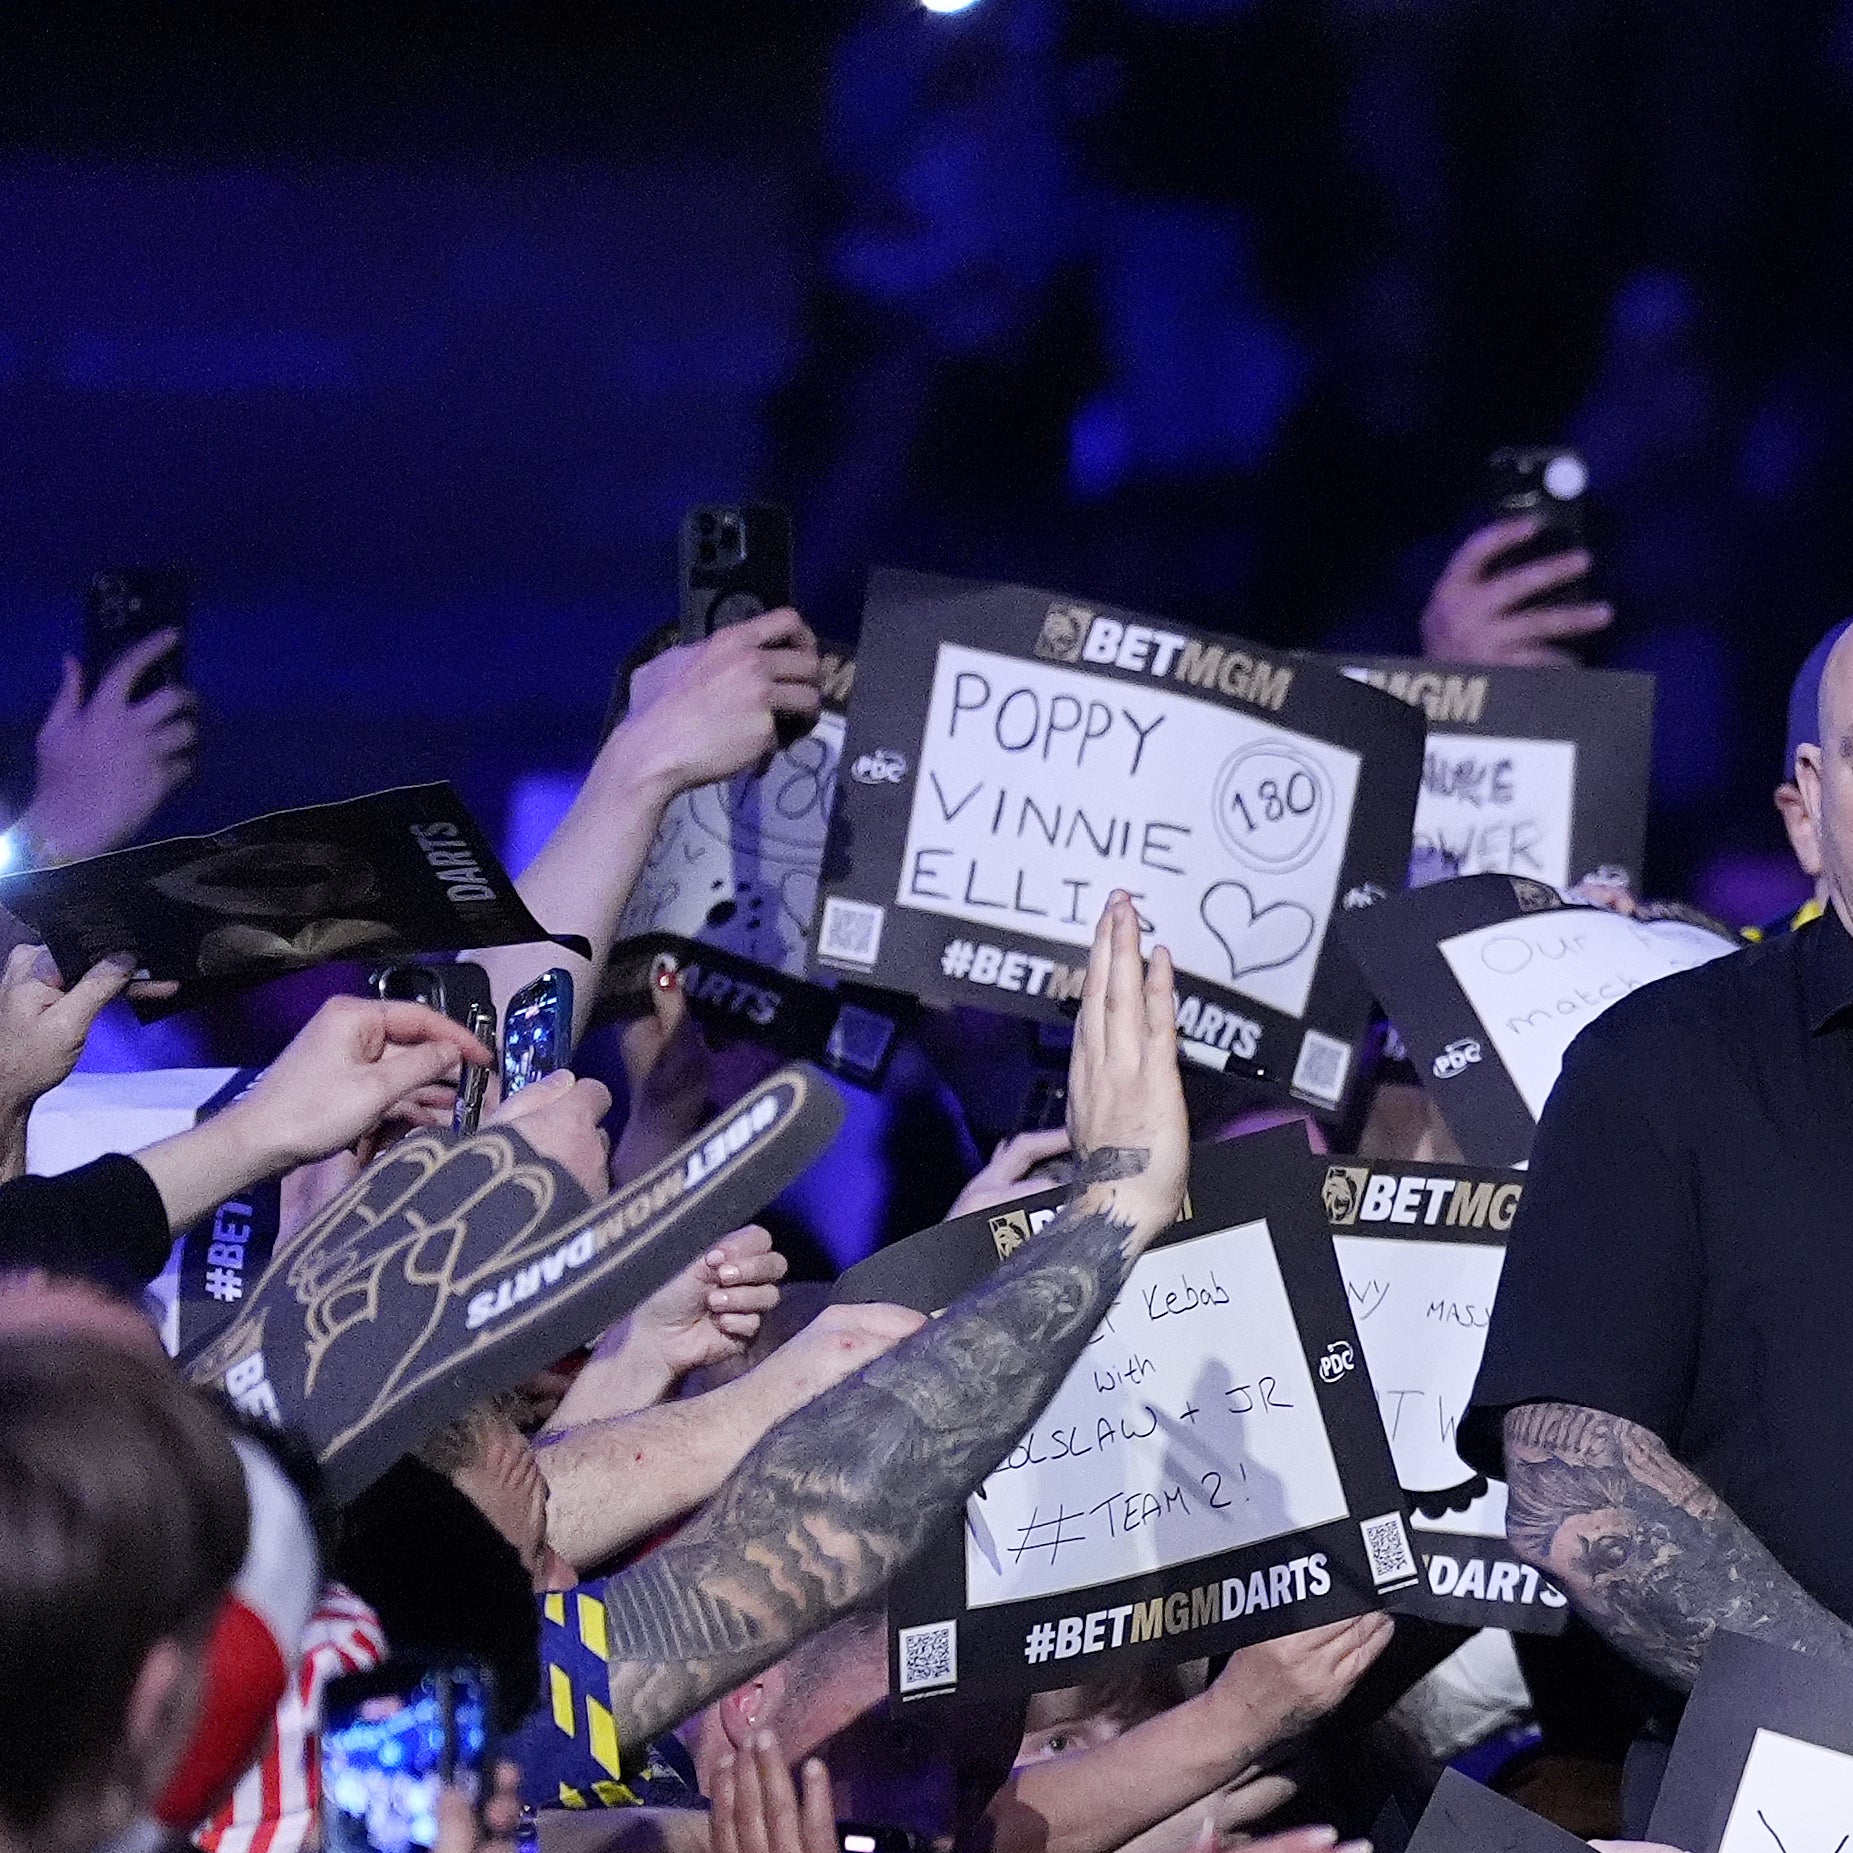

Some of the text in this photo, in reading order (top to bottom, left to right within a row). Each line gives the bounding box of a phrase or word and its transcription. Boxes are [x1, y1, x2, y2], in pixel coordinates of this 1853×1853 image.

[1081, 616, 1296, 711] BETMGM
[949, 672, 1167, 776] POPPY
[929, 769, 1317, 875] VINNIE 180
[1431, 1039, 1484, 1079] PDC
[1360, 1173, 1524, 1232] BETMG
[1318, 1340, 1355, 1384] PDC
[1023, 1552, 1334, 1666] #BETMGMDARTS
